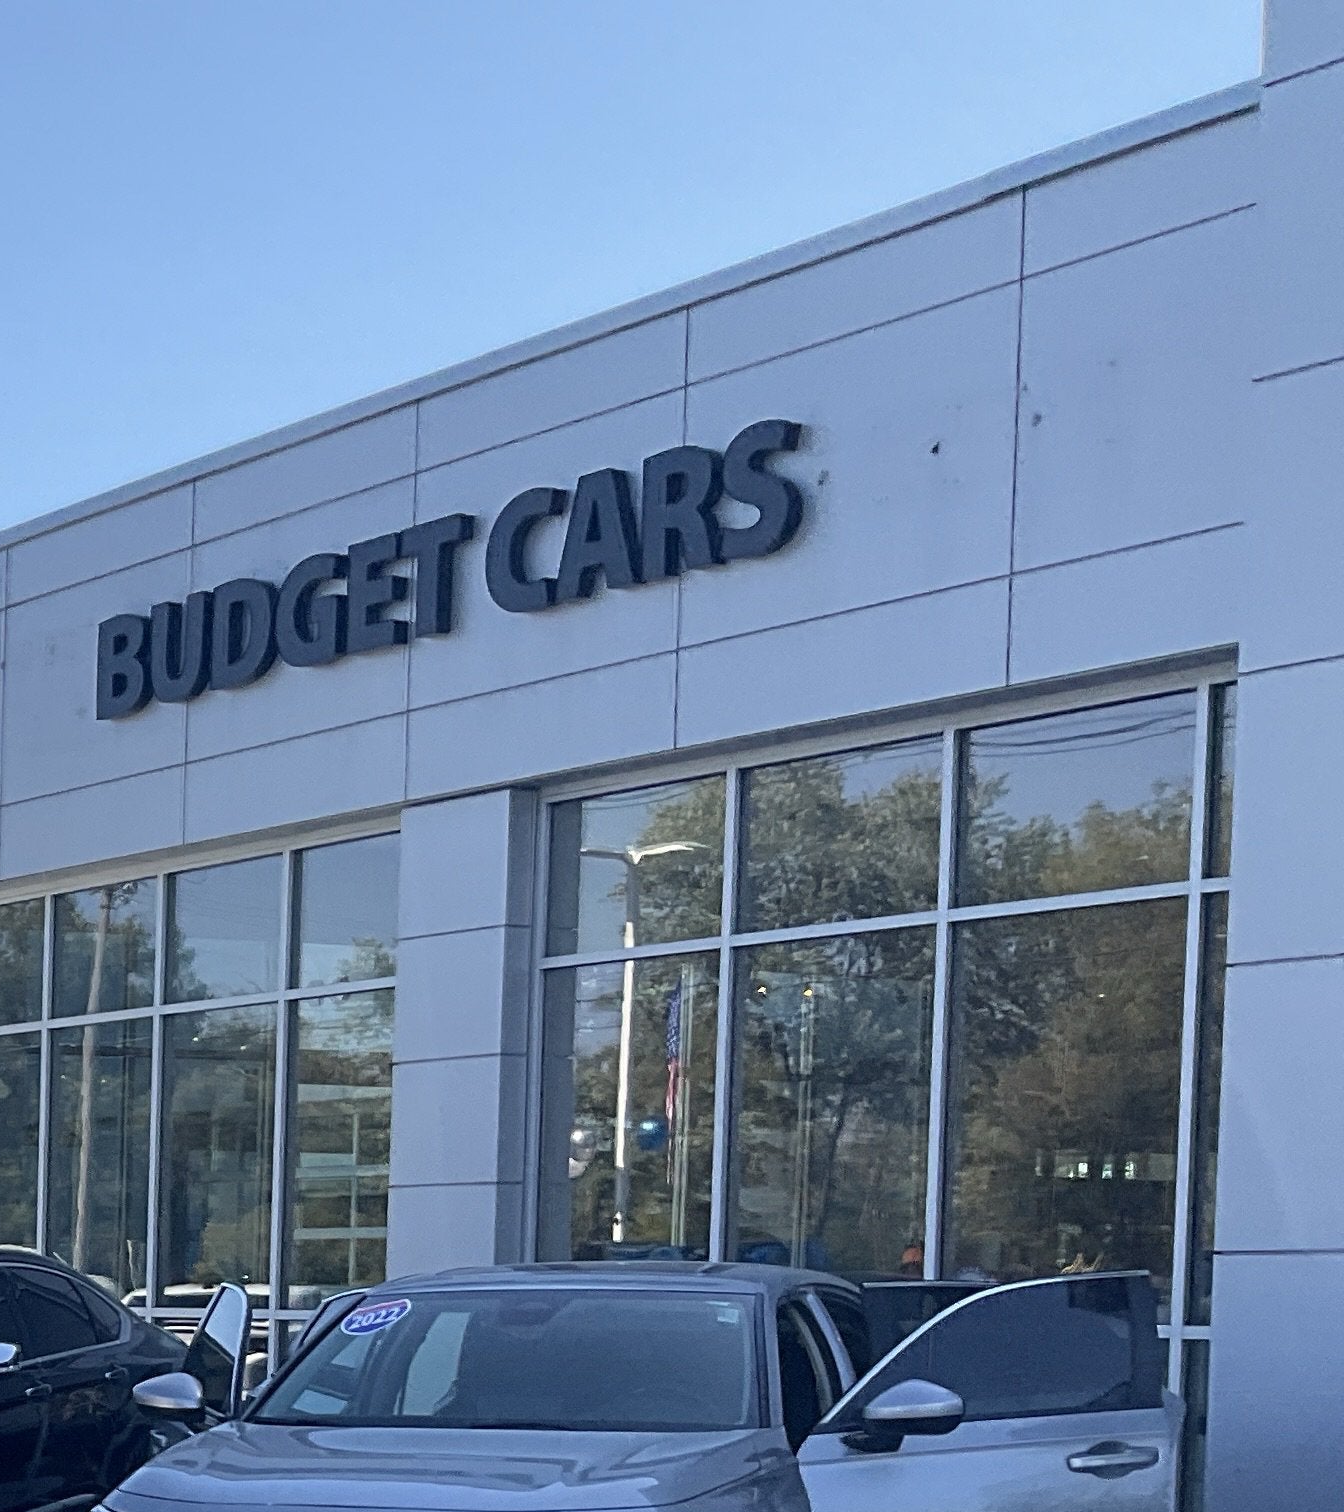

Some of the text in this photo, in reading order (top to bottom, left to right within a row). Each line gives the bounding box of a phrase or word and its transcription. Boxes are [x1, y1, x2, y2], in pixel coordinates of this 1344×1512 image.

[96, 418, 803, 720] BUDGET CARS
[347, 1308, 399, 1331] 2022
